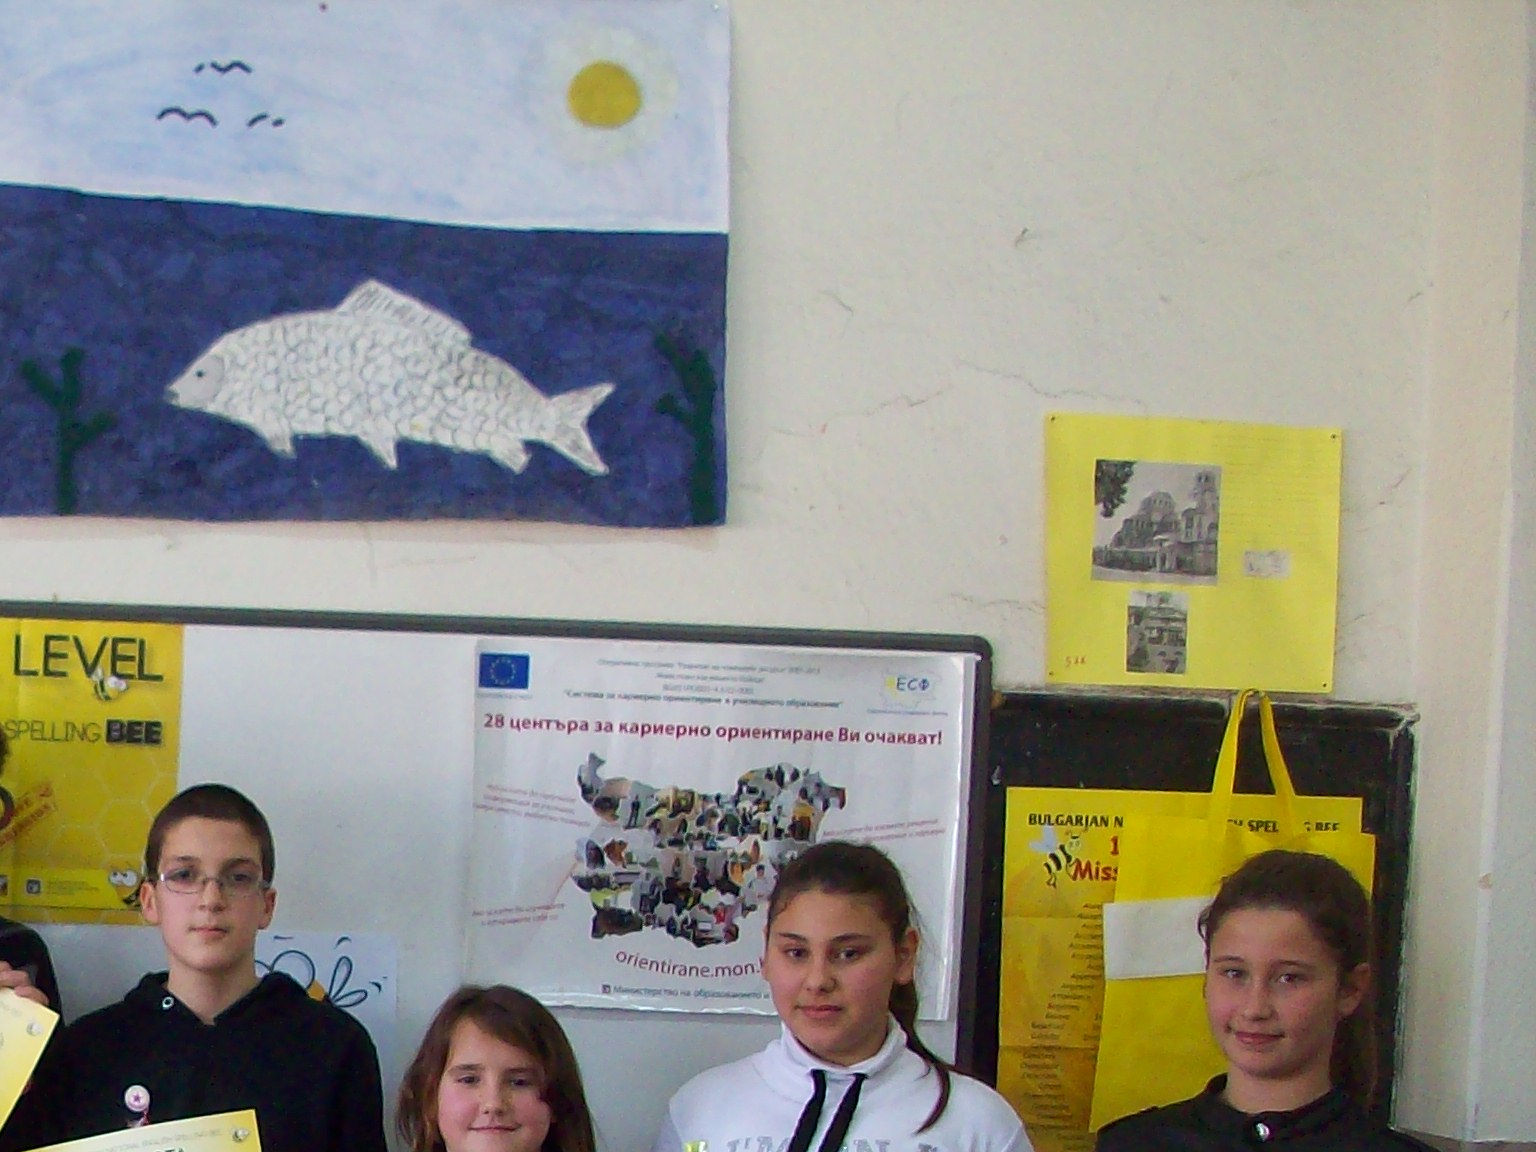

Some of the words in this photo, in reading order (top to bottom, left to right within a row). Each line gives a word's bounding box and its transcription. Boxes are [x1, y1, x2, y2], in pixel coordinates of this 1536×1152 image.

[14, 633, 164, 682] LEVEL
[896, 676, 931, 692] ЕСФ
[4, 718, 101, 744] SPELLING
[105, 718, 163, 745] BEE
[484, 713, 506, 729] 28
[510, 716, 590, 735] центъра
[594, 720, 614, 733] за
[618, 721, 712, 740] кариерно
[716, 726, 834, 744] ориентиране
[838, 727, 861, 743] Ви
[865, 730, 943, 746] очакват!
[1028, 813, 1109, 830] BULGARIAN
